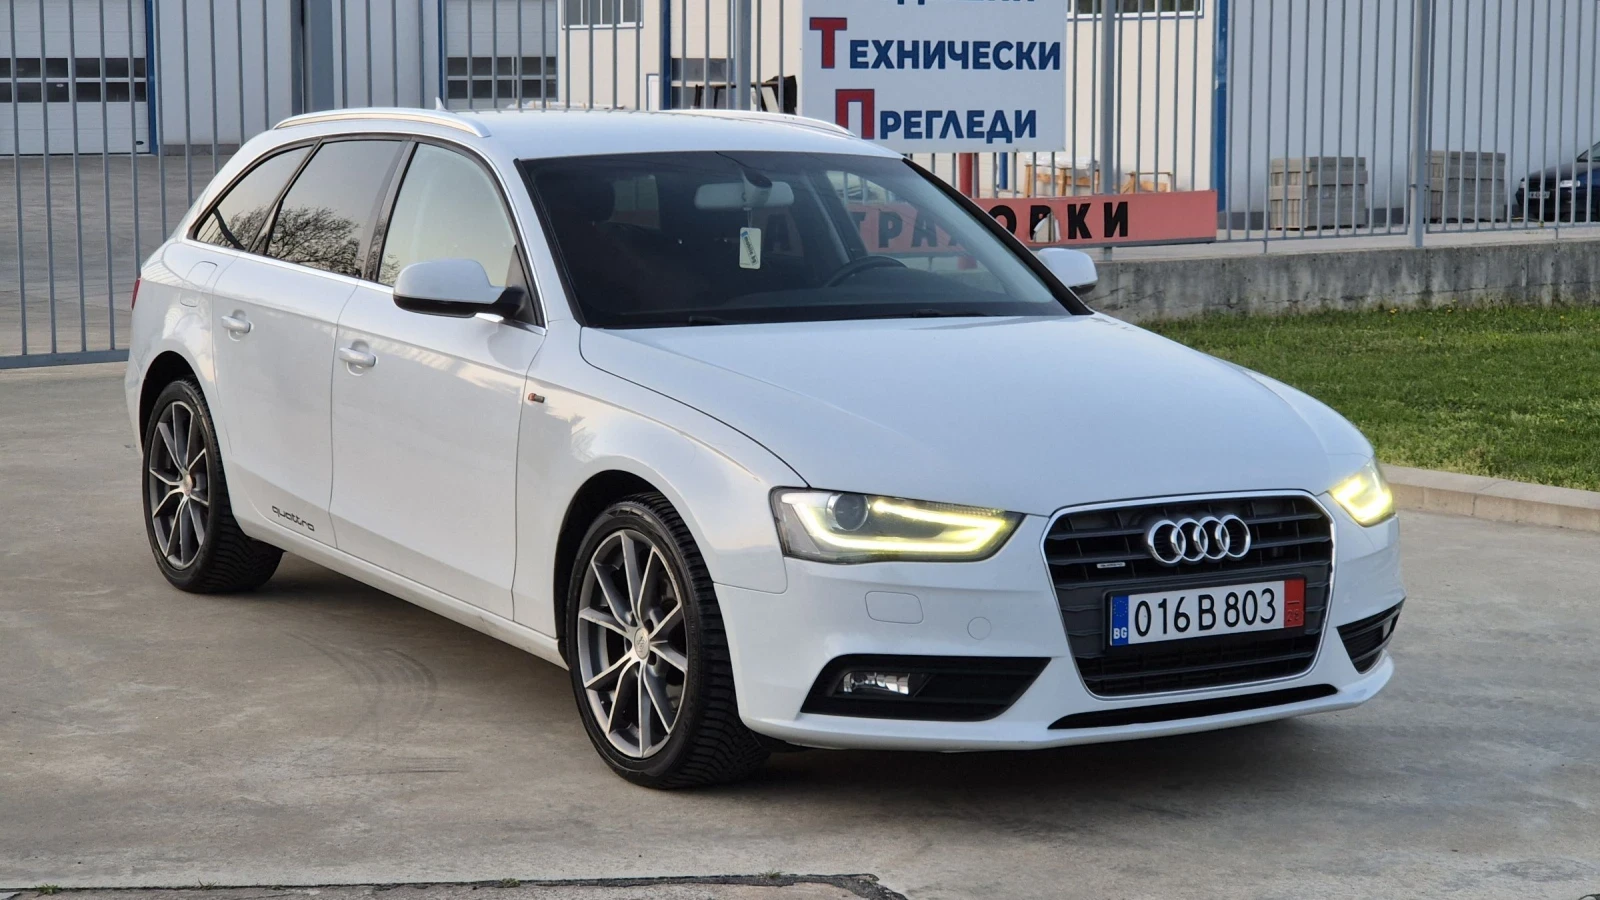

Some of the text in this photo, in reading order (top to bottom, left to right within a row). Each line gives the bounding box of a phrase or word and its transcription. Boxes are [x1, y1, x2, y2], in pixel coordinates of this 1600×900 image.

[809, 17, 1061, 71] ТЕХНИЧЕСКИ
[835, 89, 1037, 144] ПРЕГЛЕДИ
[271, 505, 315, 532] quattro
[1113, 627, 1128, 640] BG
